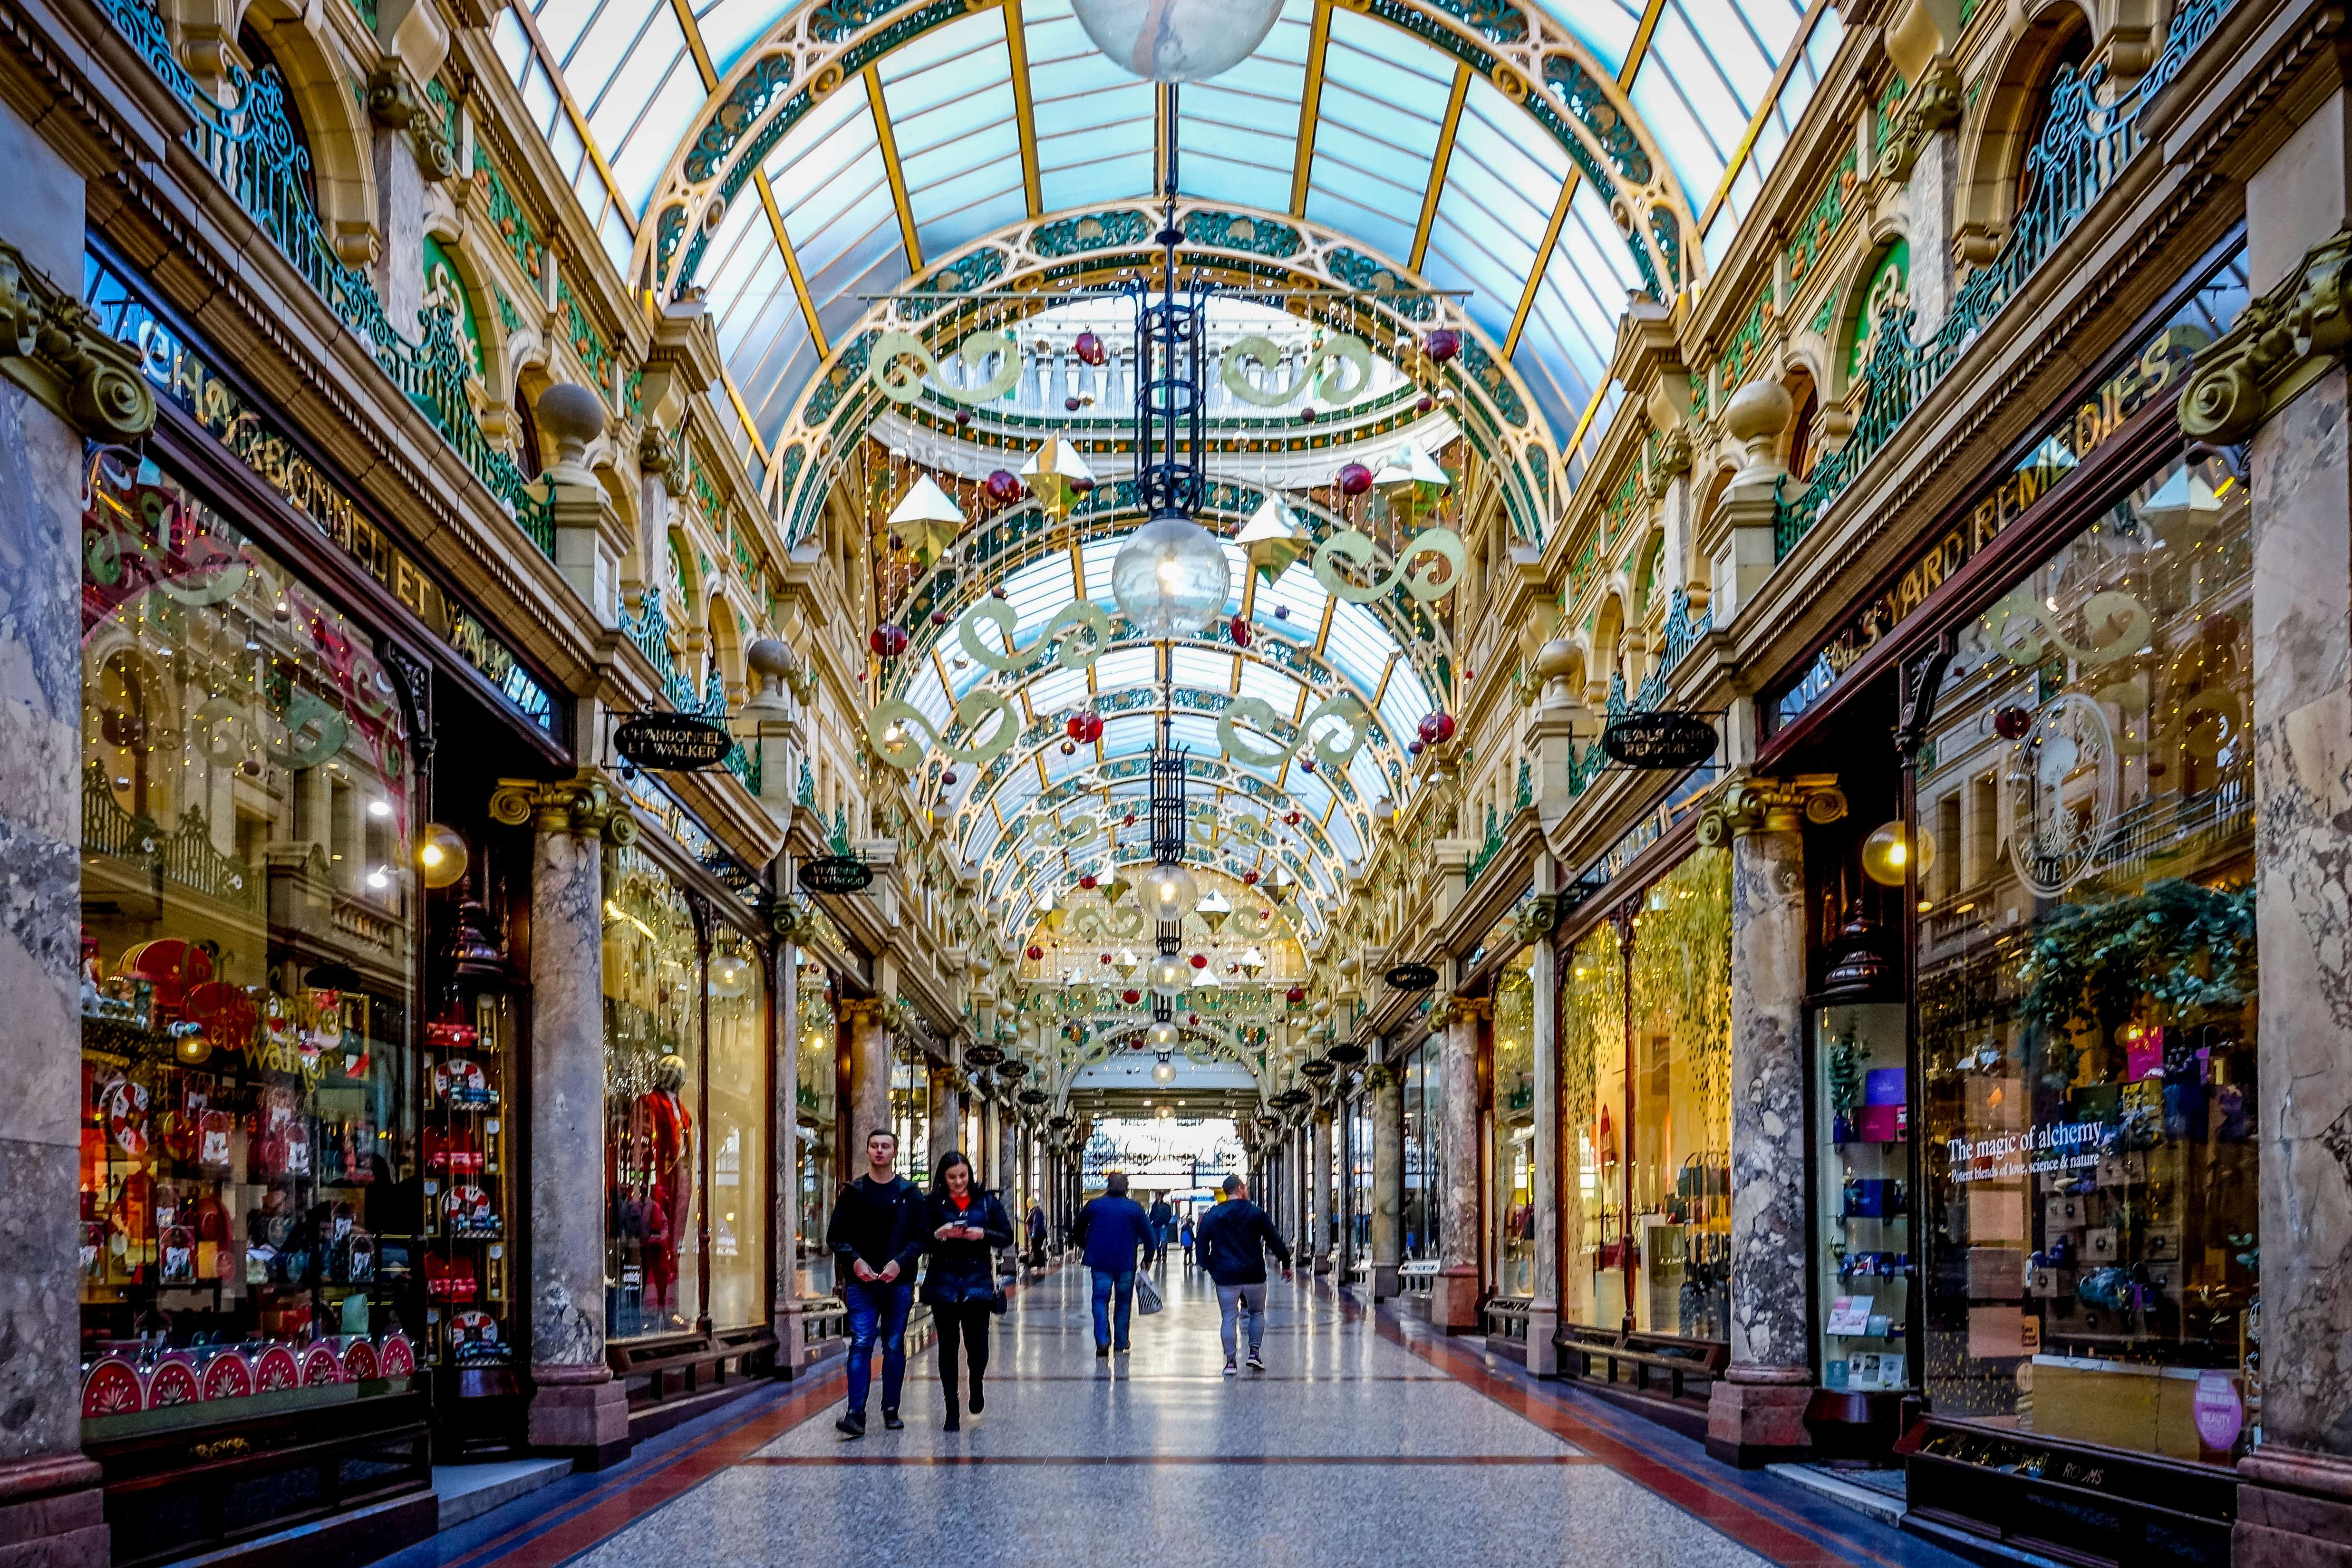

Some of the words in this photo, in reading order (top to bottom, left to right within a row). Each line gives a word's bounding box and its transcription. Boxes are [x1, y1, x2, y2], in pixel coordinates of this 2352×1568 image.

[138, 319, 386, 583] CHARBONNEL
[397, 554, 431, 615] ET
[1884, 532, 1963, 628] YARD
[1974, 328, 2170, 554] REMEDIES
[623, 727, 723, 745] CHARBONNEL
[628, 742, 645, 754] ET
[654, 742, 716, 758] WALKER
[242, 1029, 334, 1094] Walker
[1947, 1138, 1973, 1164] The
[1976, 1130, 2017, 1161] magic
[2020, 1125, 2036, 1152] of
[2039, 1120, 2103, 1149] alchemy
[1951, 1169, 1973, 1183] Potent
[1975, 1164, 1998, 1180] blends
[1998, 1162, 2010, 1176] of
[2029, 1158, 2059, 1173] science
[2060, 1154, 2068, 1170] &
[2070, 1153, 2100, 1169] nature
